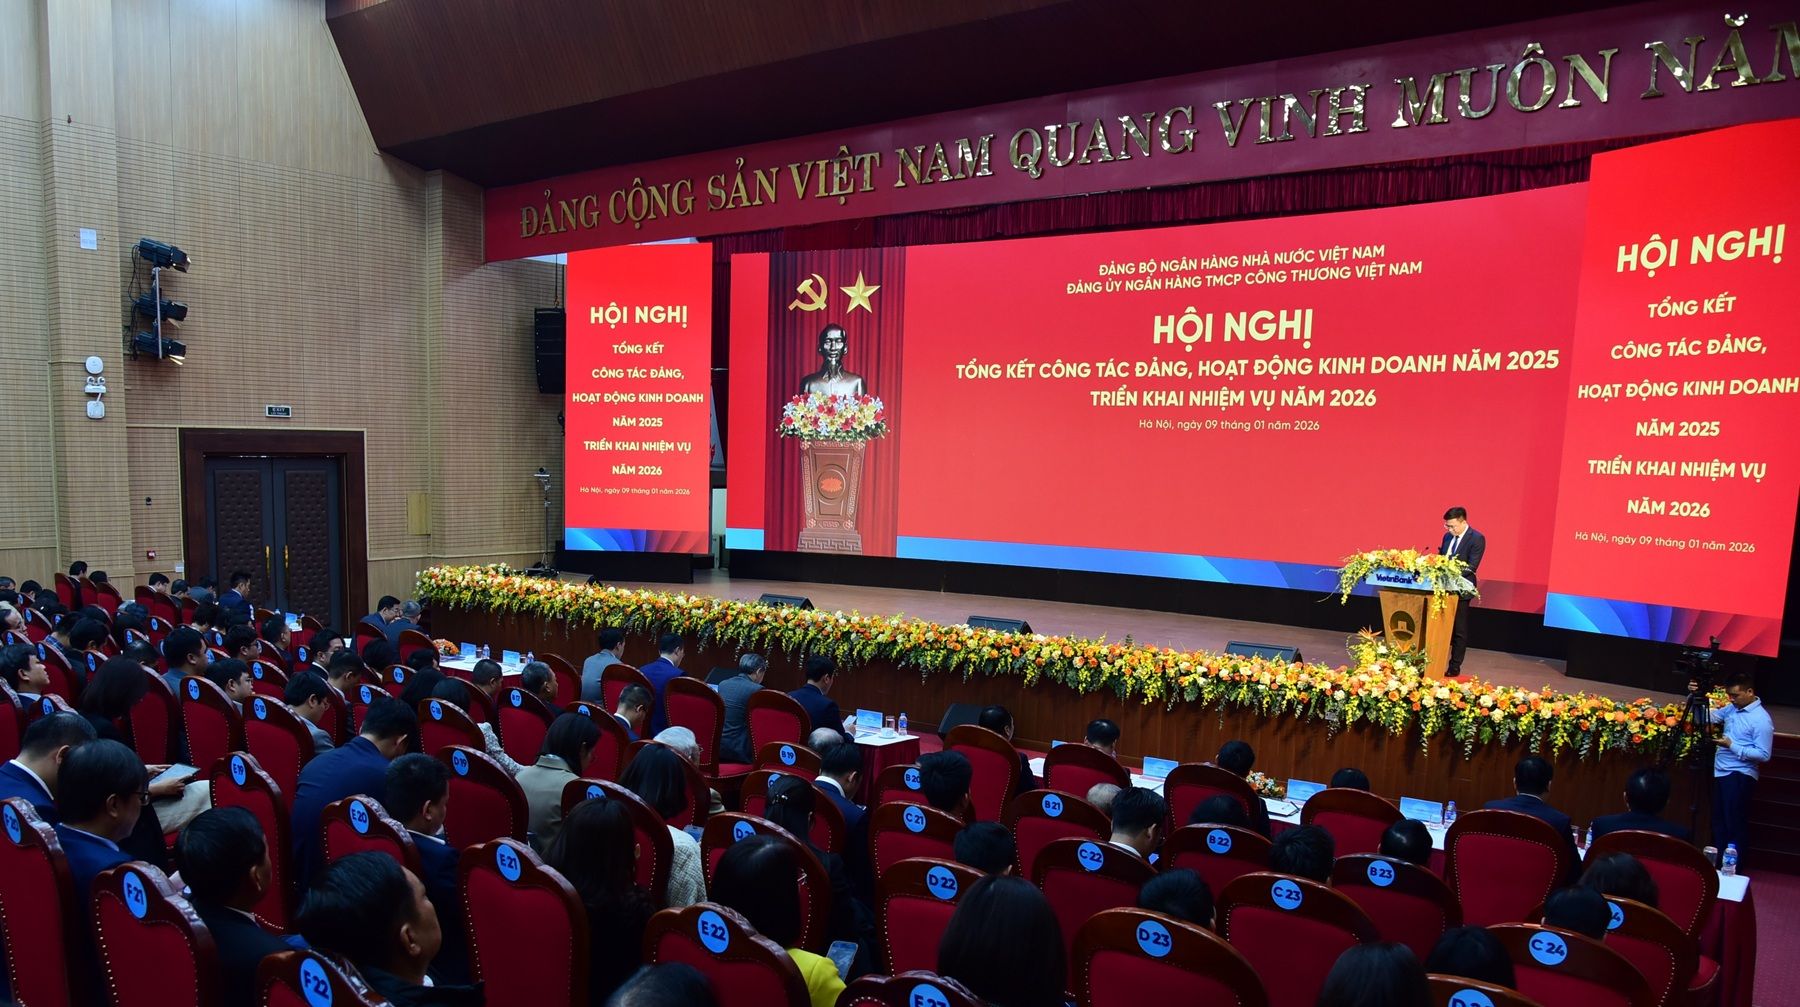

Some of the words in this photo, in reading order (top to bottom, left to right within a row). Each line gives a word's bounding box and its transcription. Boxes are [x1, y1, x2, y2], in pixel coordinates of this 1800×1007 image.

[520, 189, 601, 238] ĐẢNG
[608, 177, 694, 229] CỘNG
[707, 157, 778, 211] SẢN
[787, 145, 881, 205] VIỆT
[893, 133, 996, 188] NAM
[1009, 105, 1197, 179] QUANG
[1211, 83, 1371, 147] VINH
[1391, 42, 1619, 128] MUÔN
[1099, 261, 1135, 276] ĐẢNG
[1139, 259, 1157, 275] BỘ
[1161, 257, 1197, 272] NGÂN
[1201, 255, 1238, 269] HÀNG
[1243, 253, 1270, 267] NHÀ
[1274, 248, 1314, 264] NƯỚC
[1319, 246, 1349, 263] VIỆT
[1353, 245, 1384, 259] NAM
[1617, 234, 1678, 277] HỘI
[1690, 224, 1785, 264] NGHỊ
[1067, 280, 1102, 294] ĐẢNG
[1106, 278, 1122, 292] ỦY
[1126, 277, 1161, 291] NGÂN
[1165, 275, 1202, 289] HÀNG
[1206, 274, 1241, 286] TMCP
[1245, 269, 1287, 284] CÔNG
[1291, 266, 1351, 281] THƯƠNG
[1356, 263, 1385, 280] VIỆT
[1389, 261, 1422, 275] NAM
[591, 302, 627, 329] HỘI
[635, 306, 687, 328] NGHỊ
[1648, 296, 1698, 318] TỔNG
[1703, 292, 1736, 313] KẾT
[1154, 306, 1213, 352] HỘI
[1224, 309, 1313, 349] NGHỊ
[612, 341, 643, 354] TỔNG
[646, 341, 664, 353] KẾT
[1611, 341, 1662, 359] CÔNG
[1667, 337, 1702, 356] TÁC
[1707, 334, 1766, 354] ĐẢNG,
[592, 367, 624, 378] CÔNG
[626, 367, 647, 378] TÁC
[650, 366, 684, 379] ĐẢNG,
[956, 358, 1002, 379] TỔNG
[1007, 358, 1035, 378] KẾT
[1039, 359, 1091, 378] CÔNG
[1096, 358, 1129, 377] TÁC
[1135, 357, 1192, 379] ĐẢNG,
[1198, 360, 1248, 379] HOẠT
[1253, 355, 1313, 379] ĐỘNG
[1319, 357, 1365, 374] KINH
[1371, 355, 1446, 373] DOANH
[1453, 349, 1501, 371] NĂM
[1506, 350, 1559, 370] 2025
[572, 393, 601, 404] HOẠT
[604, 391, 636, 405] ĐỘNG
[638, 393, 663, 402] KINH
[666, 393, 704, 403] DOANH
[1090, 384, 1137, 406] TRIỂN
[1143, 391, 1184, 406] KHAI
[1189, 387, 1244, 411] NHIỆM
[1250, 390, 1275, 411] VỤ
[1281, 386, 1324, 406] NĂM
[1330, 389, 1376, 406] 2026
[1578, 384, 1622, 402] HOẠT
[1626, 379, 1678, 401] ĐỘNG
[1683, 380, 1725, 396] KINH
[1729, 377, 1799, 394] DOANH
[613, 415, 636, 426] NĂM
[638, 417, 663, 427] 2025
[1139, 420, 1152, 428] Hà
[1156, 420, 1174, 430] Nội,
[1177, 420, 1202, 431] ngày
[1205, 420, 1218, 429] 09
[1221, 420, 1251, 432] tháng
[1254, 420, 1264, 429] 01
[1268, 421, 1291, 429] năm
[1294, 420, 1319, 430] 2026
[1636, 418, 1674, 436] NĂM
[1678, 421, 1720, 436] 2025
[584, 438, 612, 450] TRIỂN
[615, 441, 639, 451] KHAI
[642, 440, 674, 453] NHIỆM
[677, 442, 691, 454] VỤ
[612, 464, 636, 475] NĂM
[638, 466, 662, 476] 2026
[1588, 455, 1632, 475] TRIỂN
[1636, 461, 1676, 476] KHAI
[1680, 459, 1735, 481] NHIỆM
[1741, 463, 1766, 483] VỤ
[1627, 497, 1665, 515] NĂM
[1669, 501, 1710, 517] 2026
[1575, 532, 1588, 540] Hà
[1591, 533, 1608, 543] Nội,
[1612, 535, 1636, 545] ngày
[1639, 536, 1652, 544] 09
[1655, 537, 1685, 549] tháng
[1689, 539, 1699, 548] 01
[1702, 541, 1725, 550] năm
[1729, 542, 1755, 552] 2026
